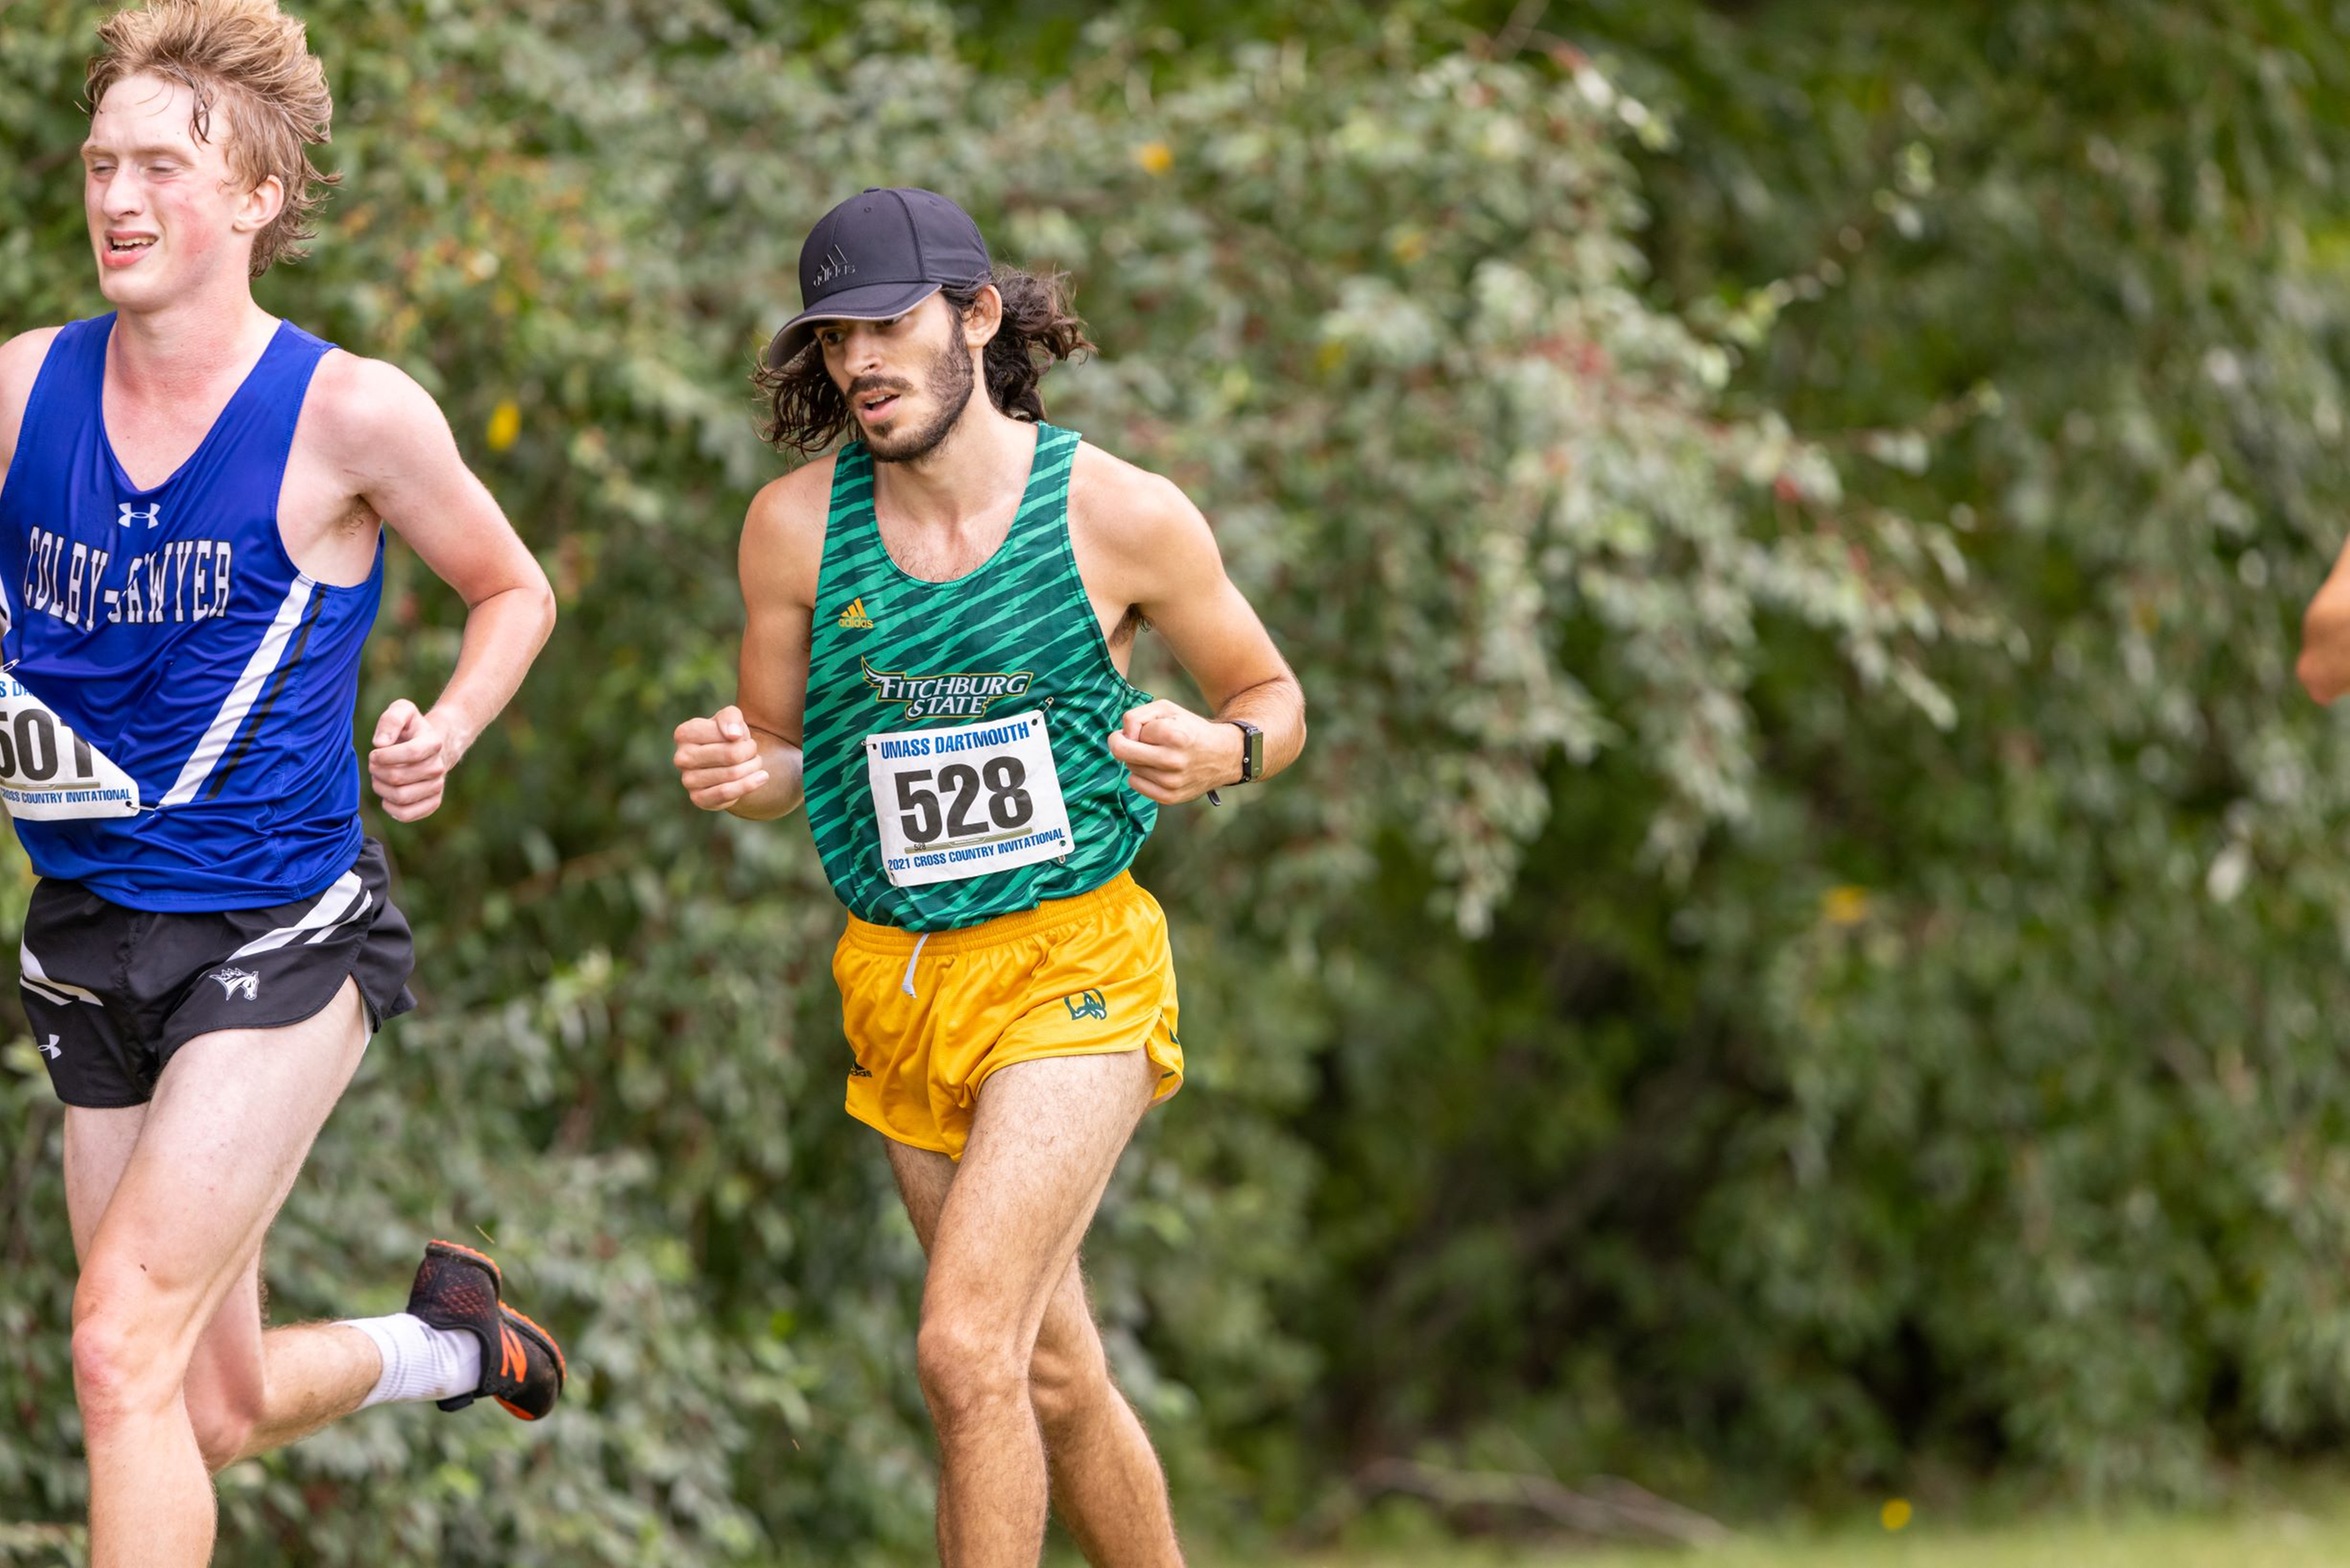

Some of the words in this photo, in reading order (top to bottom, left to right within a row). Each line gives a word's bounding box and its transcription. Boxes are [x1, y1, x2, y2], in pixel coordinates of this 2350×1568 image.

[838, 616, 874, 629] adidas
[865, 665, 1030, 699] FITCHBURG
[907, 696, 987, 718] STATE
[881, 737, 931, 760] UMASS
[935, 721, 1031, 754] DARTMOUTH
[22, 792, 63, 804] COUNTRY
[66, 788, 132, 803] INVITATIONAL
[894, 756, 1034, 844] 528
[888, 858, 911, 871] 2021
[914, 853, 947, 868] CROSS
[949, 845, 994, 863] COUNTRY
[998, 828, 1066, 854] INVITATIONAL
